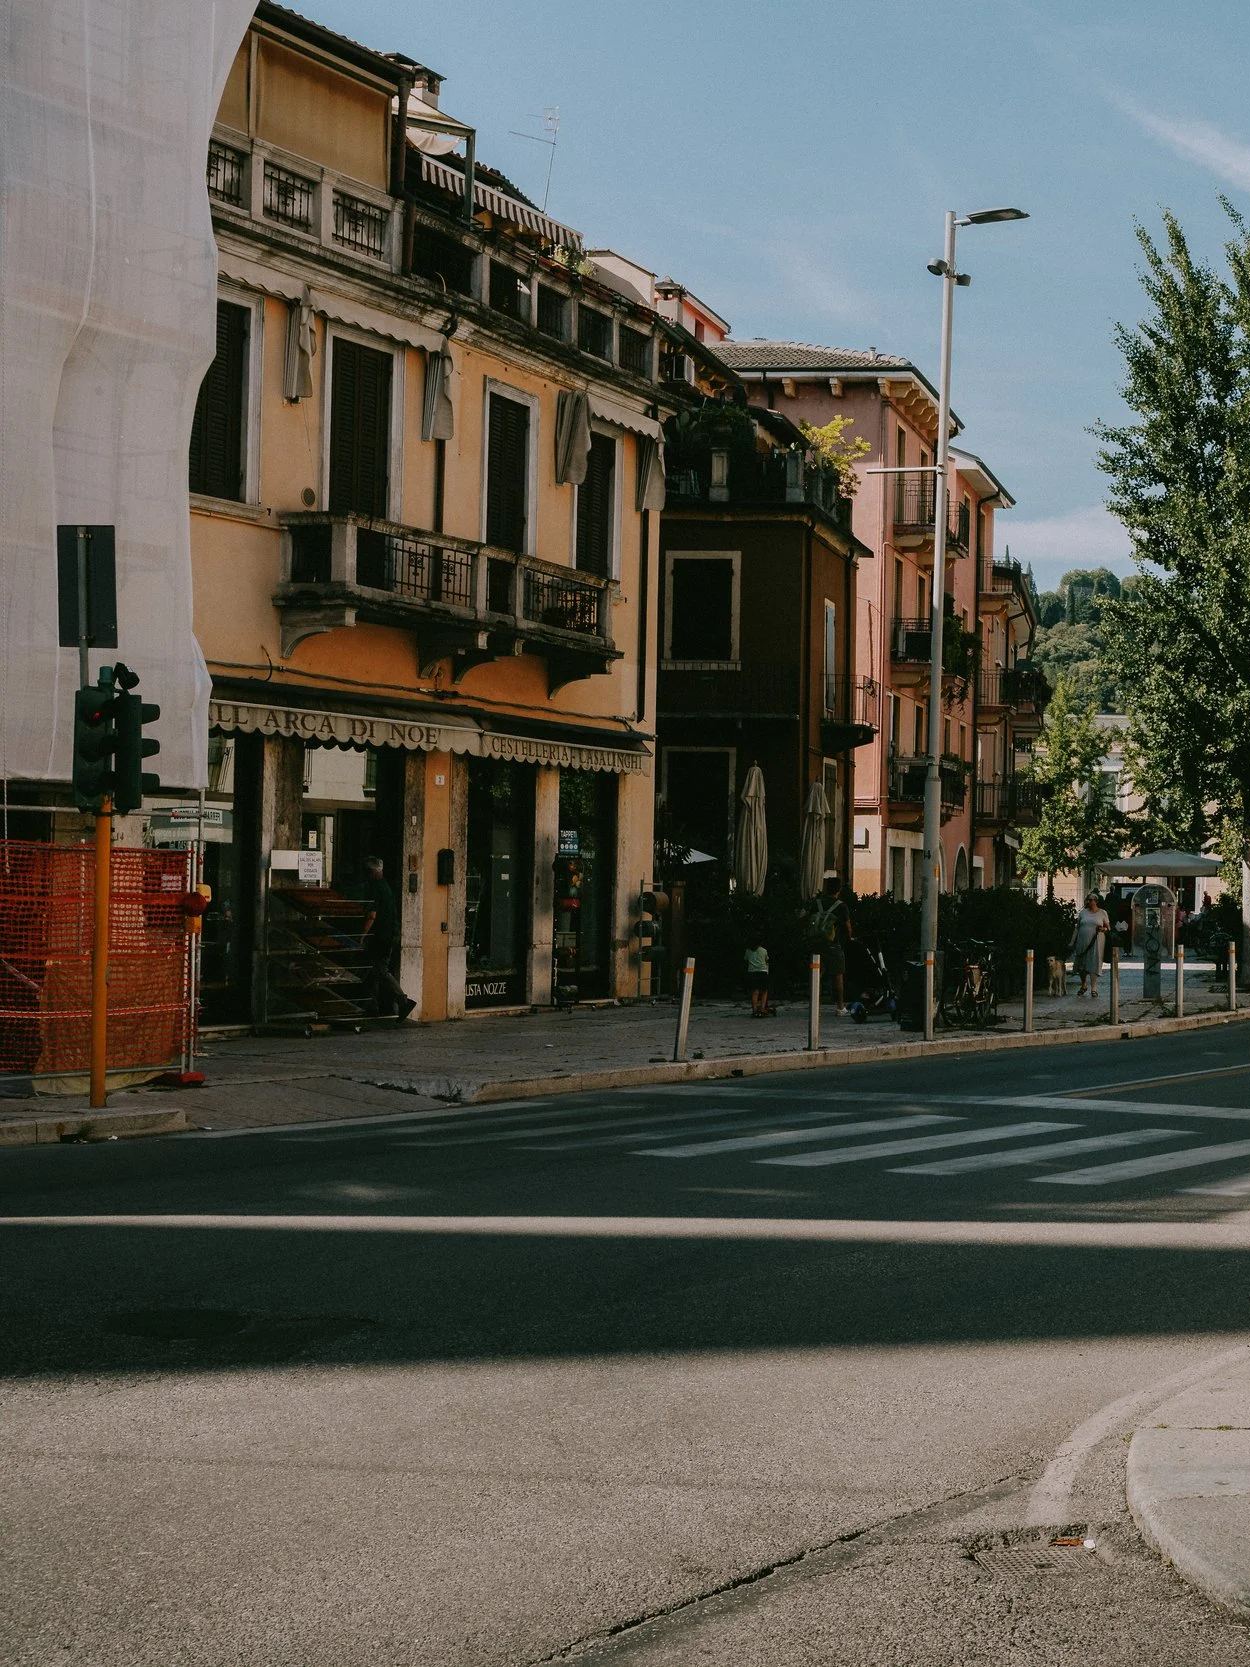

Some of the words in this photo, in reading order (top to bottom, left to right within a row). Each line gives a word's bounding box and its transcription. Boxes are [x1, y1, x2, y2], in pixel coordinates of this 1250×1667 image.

[208, 703, 250, 724] LL'
[264, 710, 336, 734] ARCA
[351, 719, 377, 738] DI
[491, 737, 569, 761] CESTELLERIA
[579, 748, 642, 770] CASALINGHI
[465, 983, 482, 997] LISTA
[483, 982, 507, 995] NOZZE
